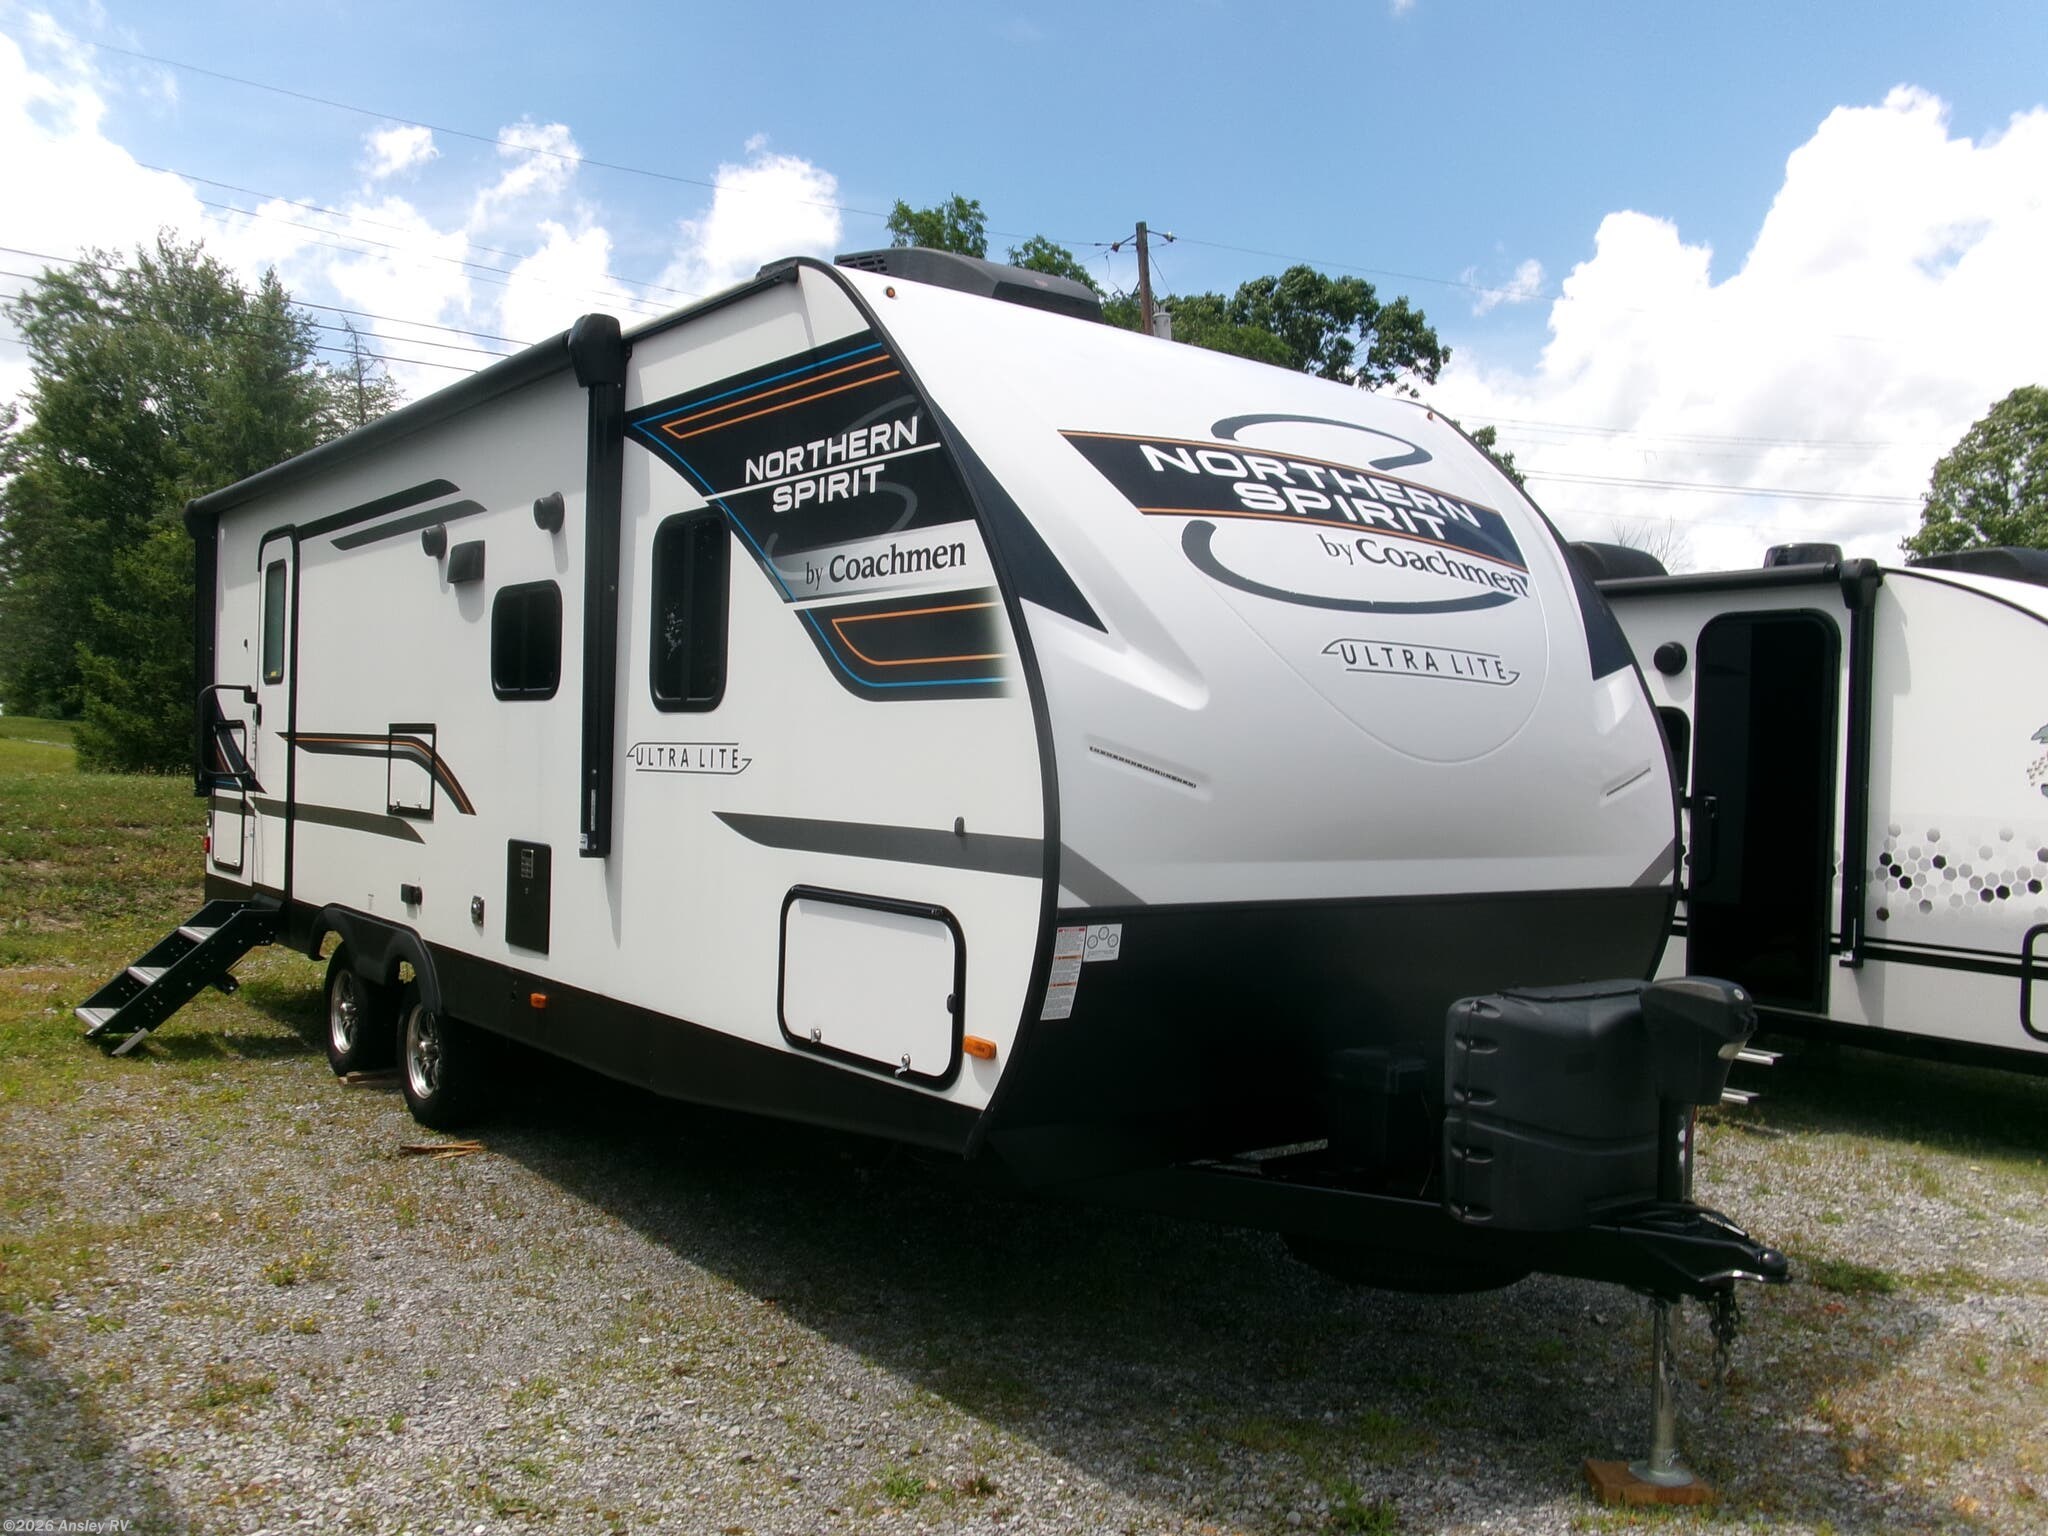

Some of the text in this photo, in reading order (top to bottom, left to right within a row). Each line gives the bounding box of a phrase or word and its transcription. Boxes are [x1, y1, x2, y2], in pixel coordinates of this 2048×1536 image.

[745, 415, 918, 484] NORTHERN
[772, 463, 885, 513] SPIRIT
[1139, 444, 1482, 529] NORTHERN
[1233, 482, 1447, 540] SPIRIT
[805, 538, 967, 591] by Coachmen
[1316, 533, 1530, 598] by Coachmen
[1340, 643, 1507, 680] ULTRA LITE
[636, 747, 739, 769] ULTRA LITE
